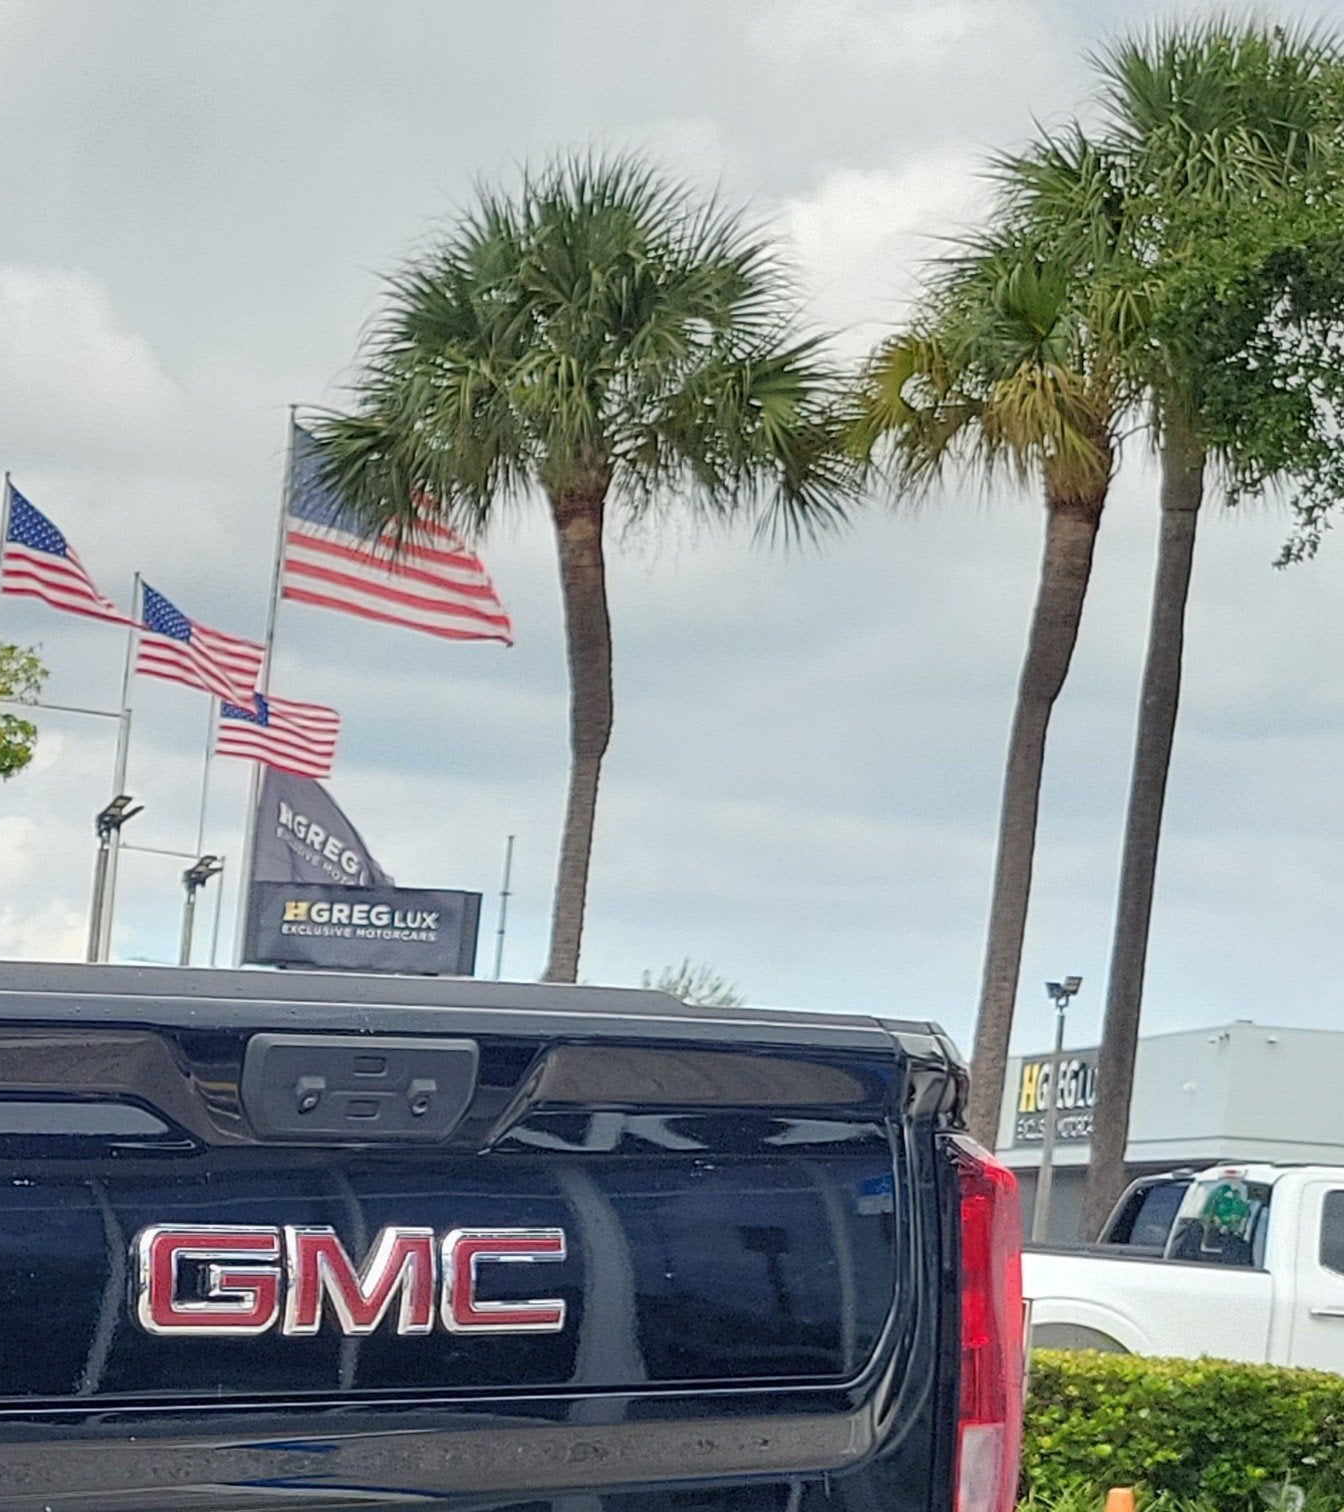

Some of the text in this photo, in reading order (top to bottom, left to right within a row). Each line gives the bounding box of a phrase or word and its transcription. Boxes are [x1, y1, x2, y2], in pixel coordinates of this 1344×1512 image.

[281, 923, 438, 943] EXCLUSIVE MOTORCARS
[135, 1223, 566, 1336] GMC
